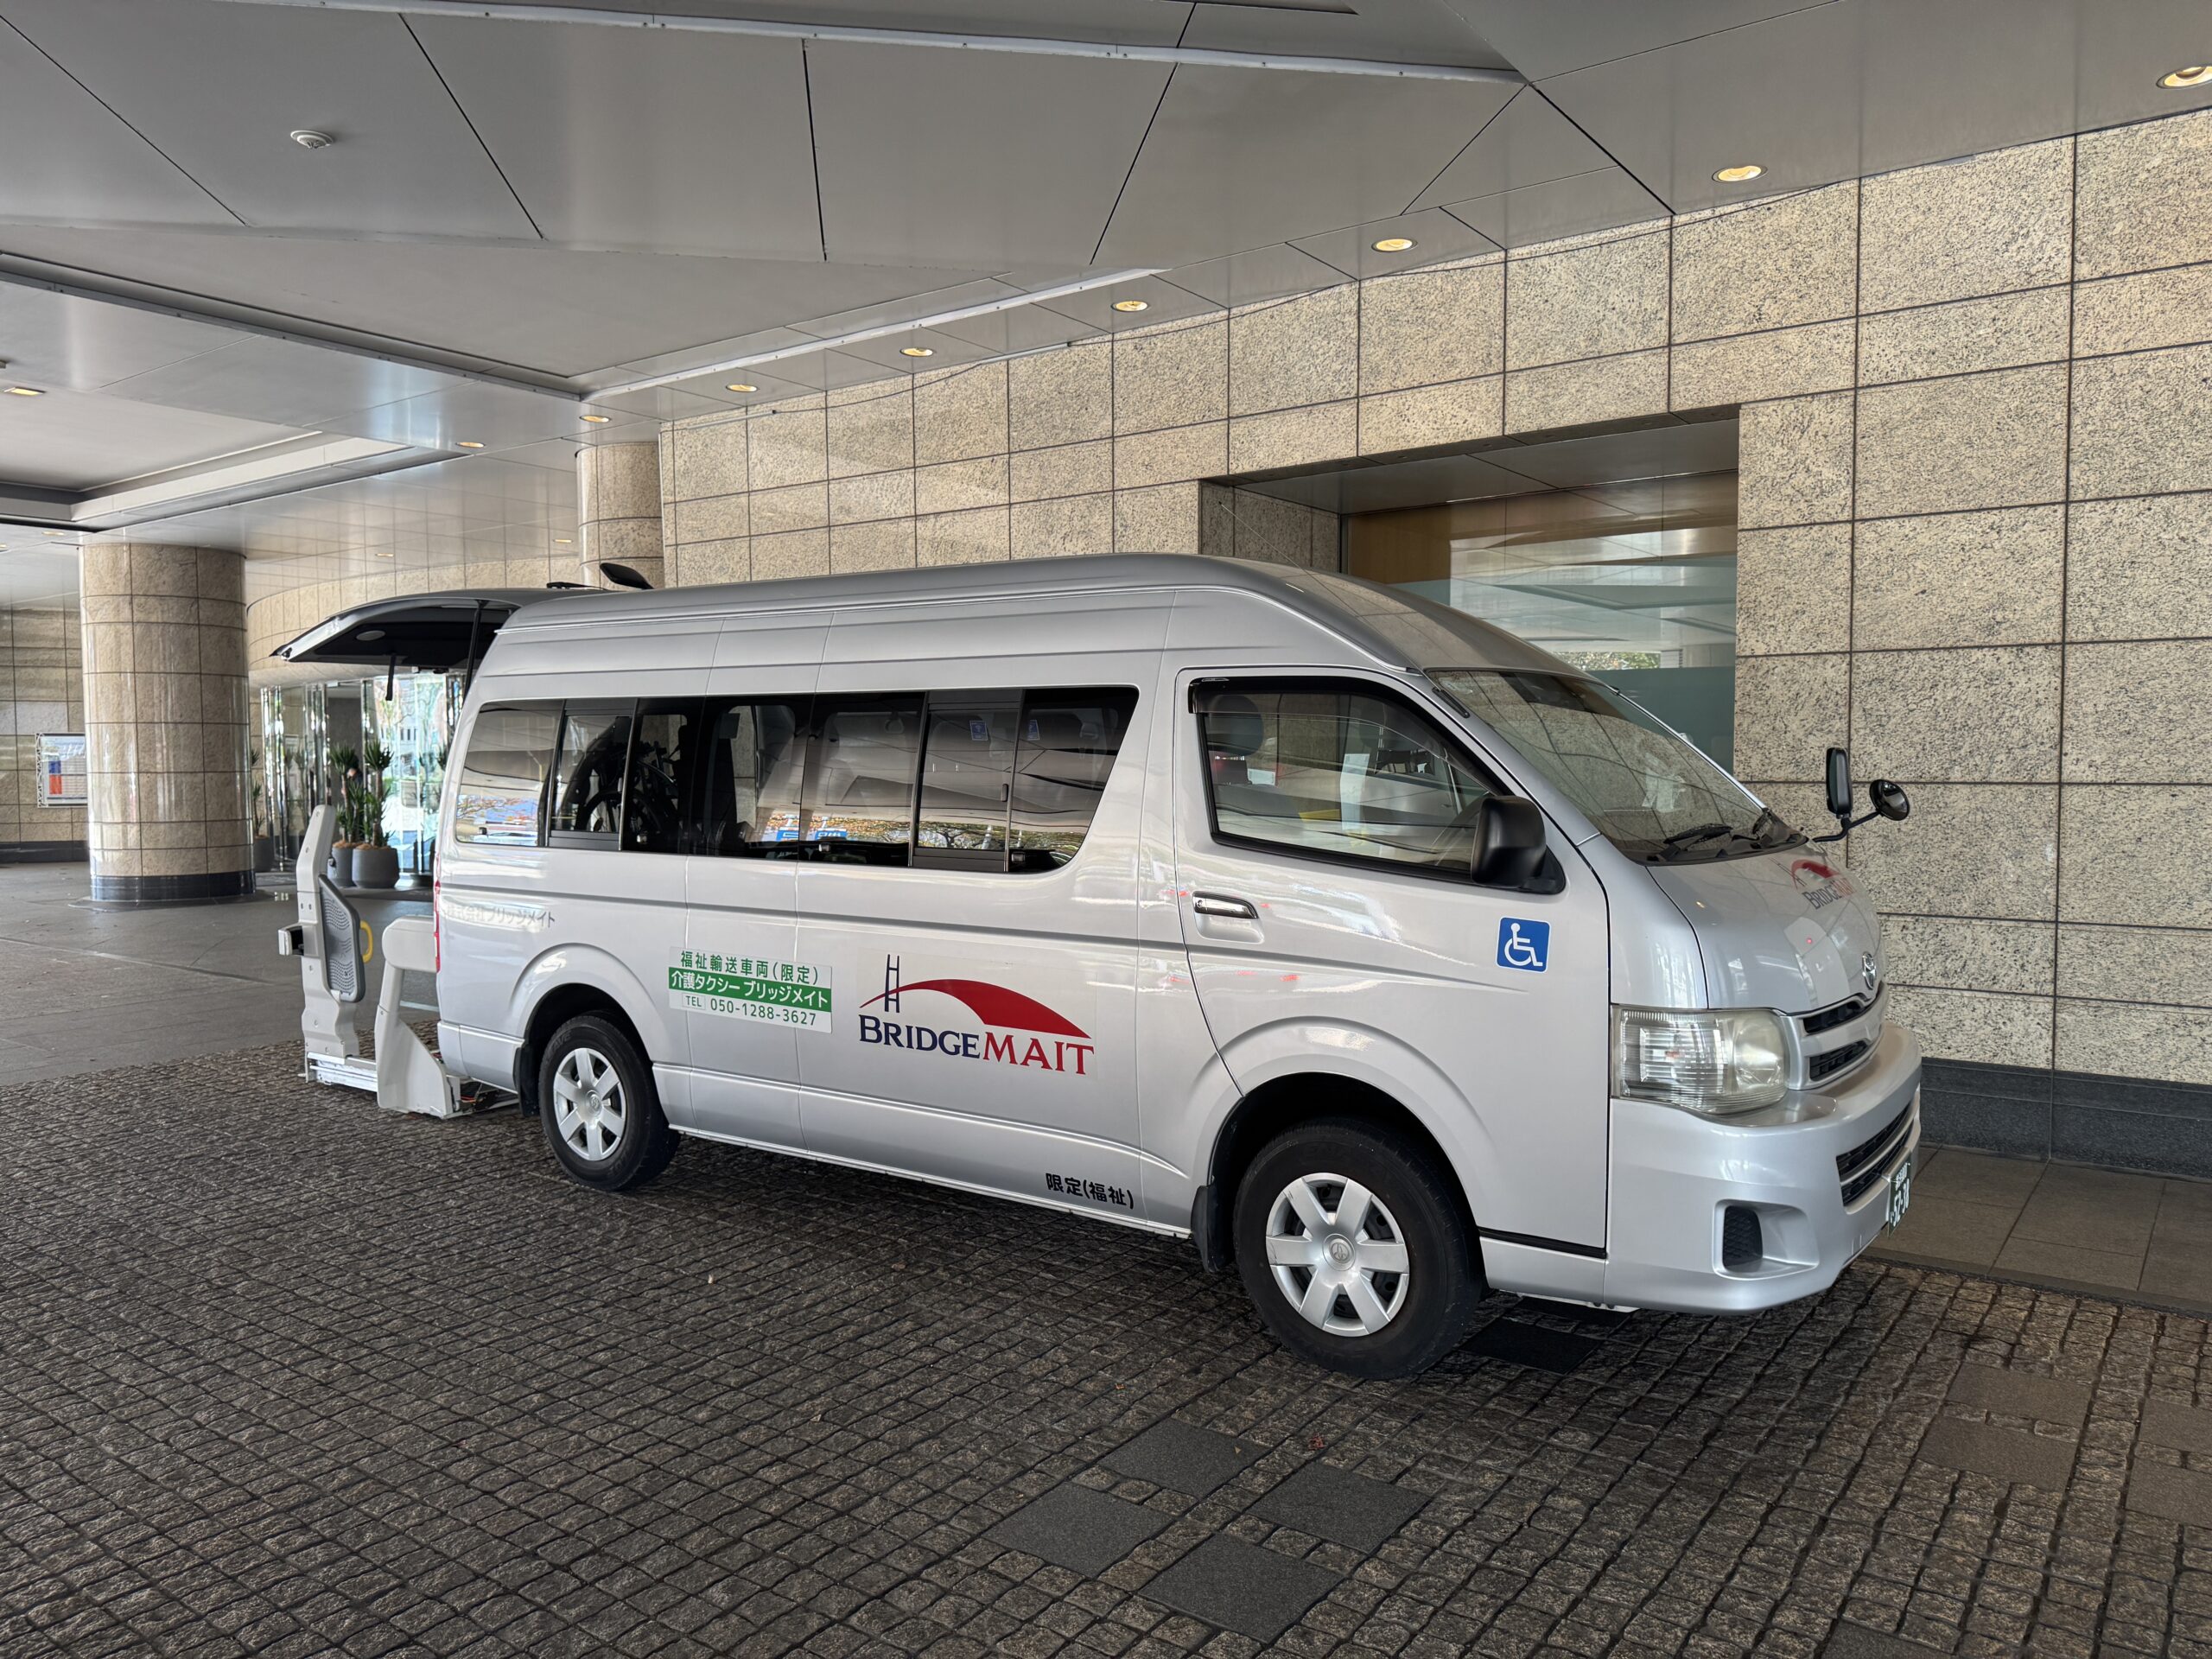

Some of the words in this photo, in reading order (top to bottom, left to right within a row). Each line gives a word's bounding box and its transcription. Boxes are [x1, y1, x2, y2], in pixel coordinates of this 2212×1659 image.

[680, 950, 819, 986] 福祉輸送車両(限定)
[671, 969, 741, 993] 介護タクシー
[743, 981, 828, 1008] ブリッジメイト
[685, 995, 702, 1008] TEL
[710, 998, 817, 1026] 050-1288-3627
[1046, 1173, 1135, 1210] 限定(福祉)
